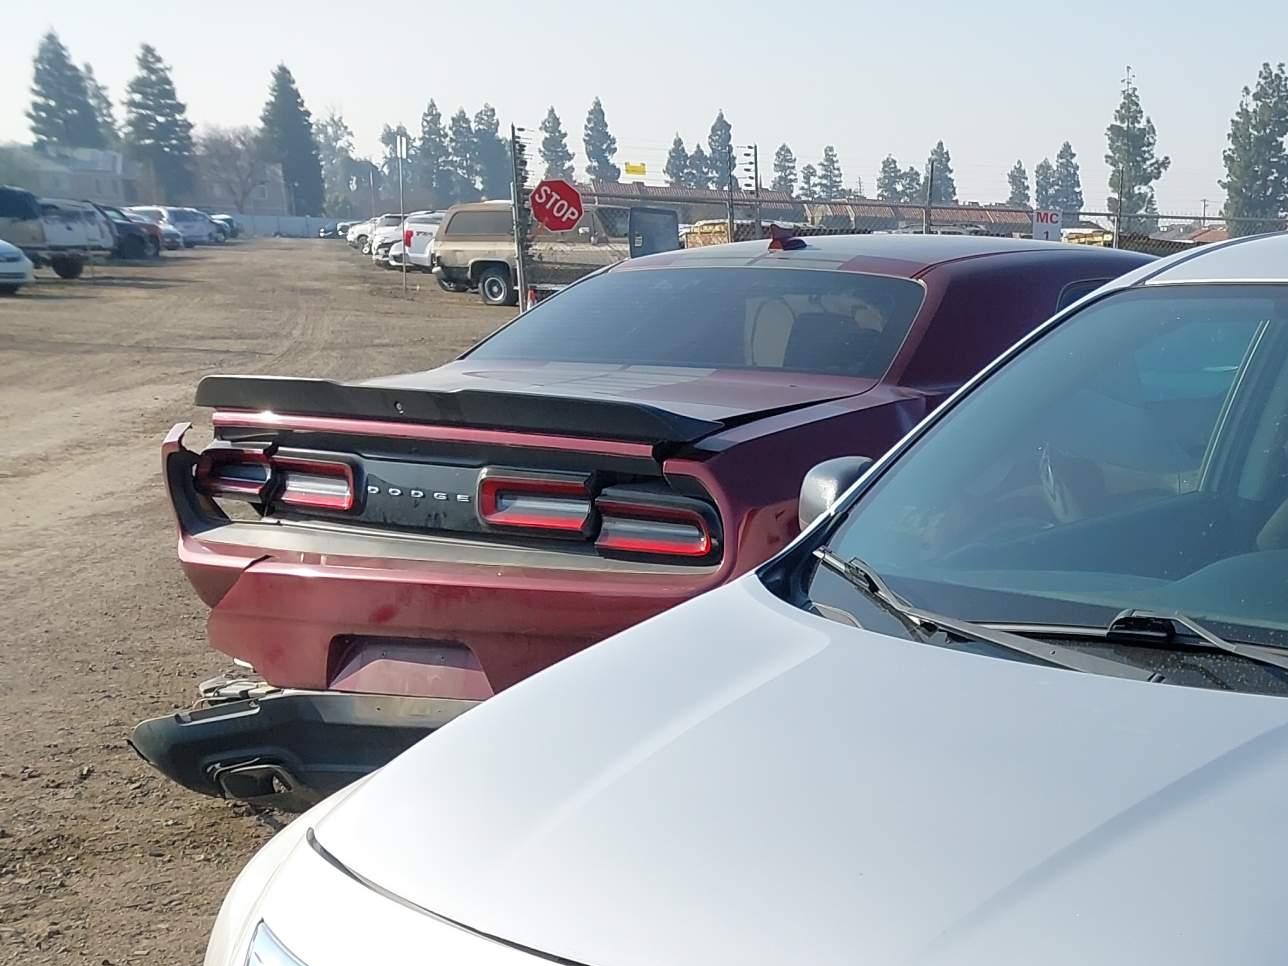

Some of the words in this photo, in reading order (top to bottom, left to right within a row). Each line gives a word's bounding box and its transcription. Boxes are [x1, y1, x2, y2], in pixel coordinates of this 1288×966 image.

[535, 185, 579, 222] STOP
[1036, 212, 1060, 224] MC
[368, 485, 471, 502] DODGE
